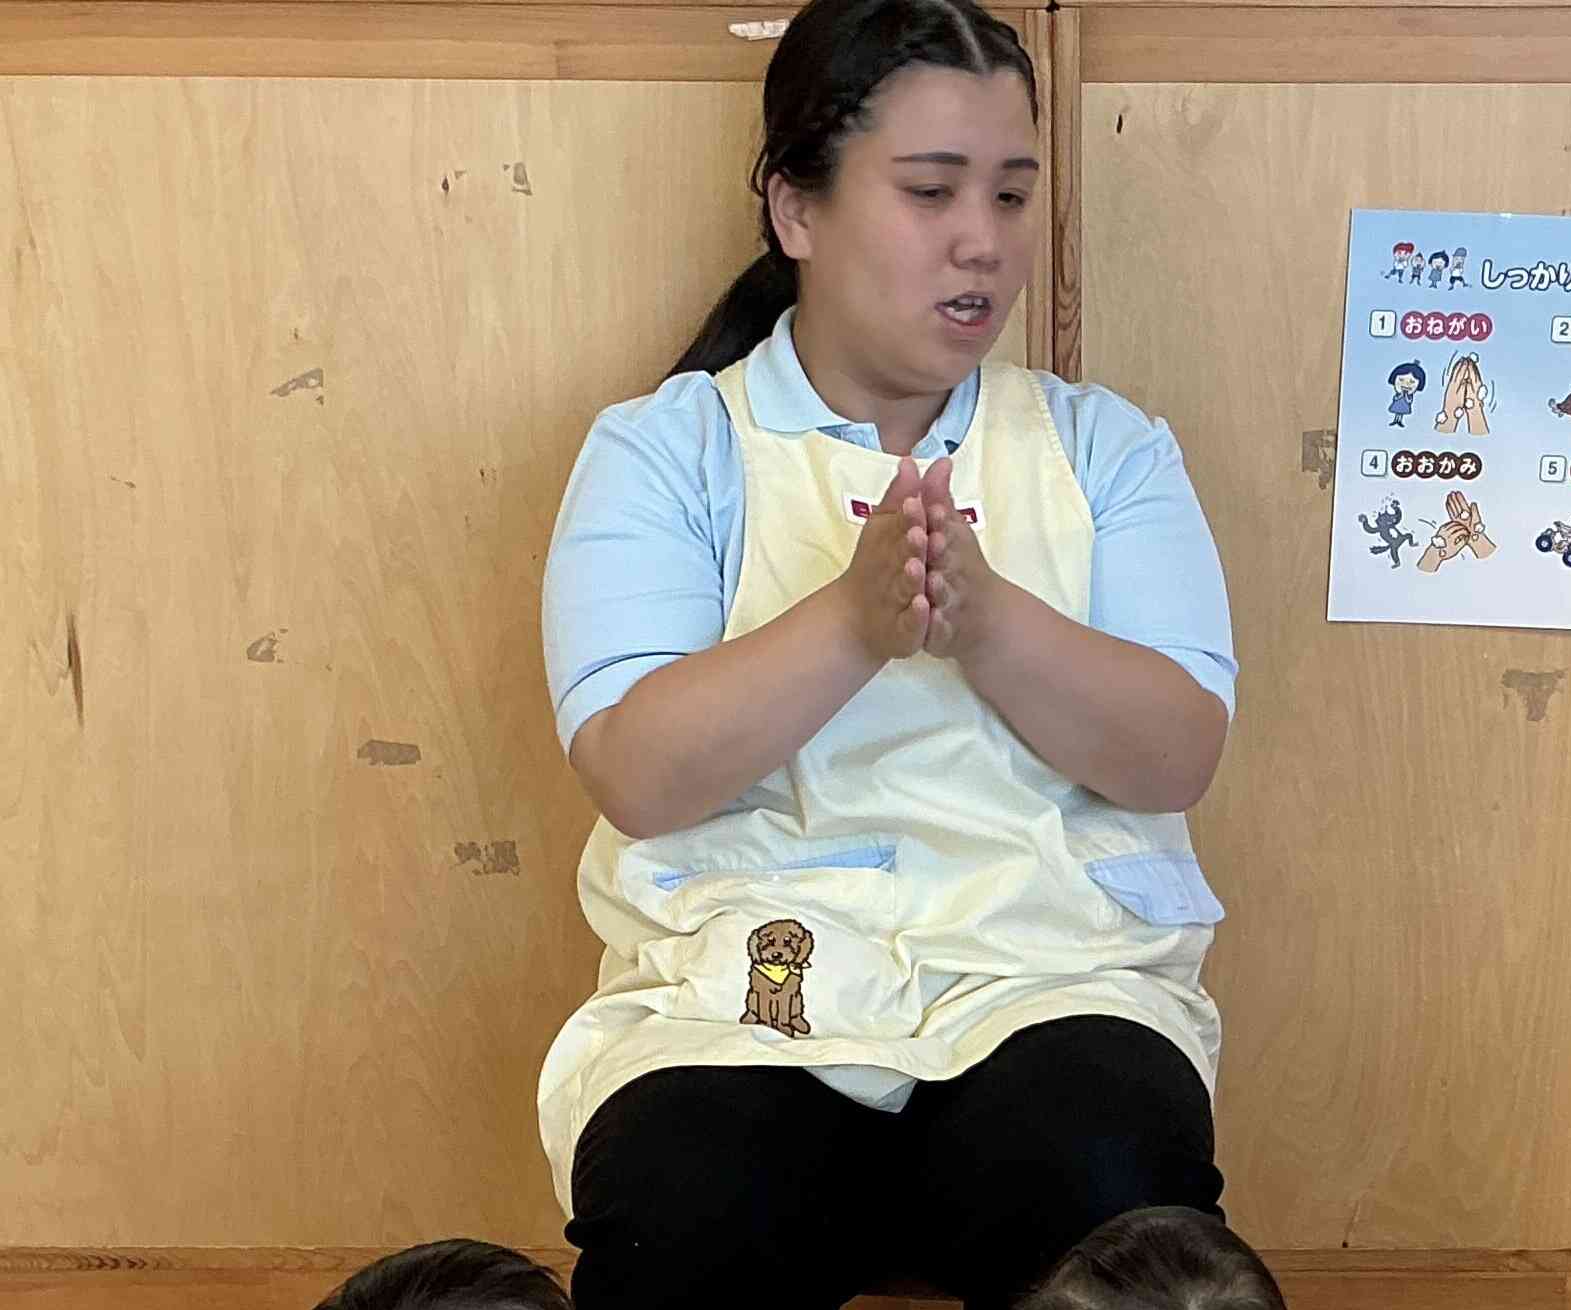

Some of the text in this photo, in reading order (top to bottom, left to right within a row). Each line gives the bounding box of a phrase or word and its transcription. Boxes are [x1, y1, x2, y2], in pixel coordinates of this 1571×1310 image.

[1404, 315, 1488, 335] おねがい
[1395, 455, 1477, 474] おおかみ
